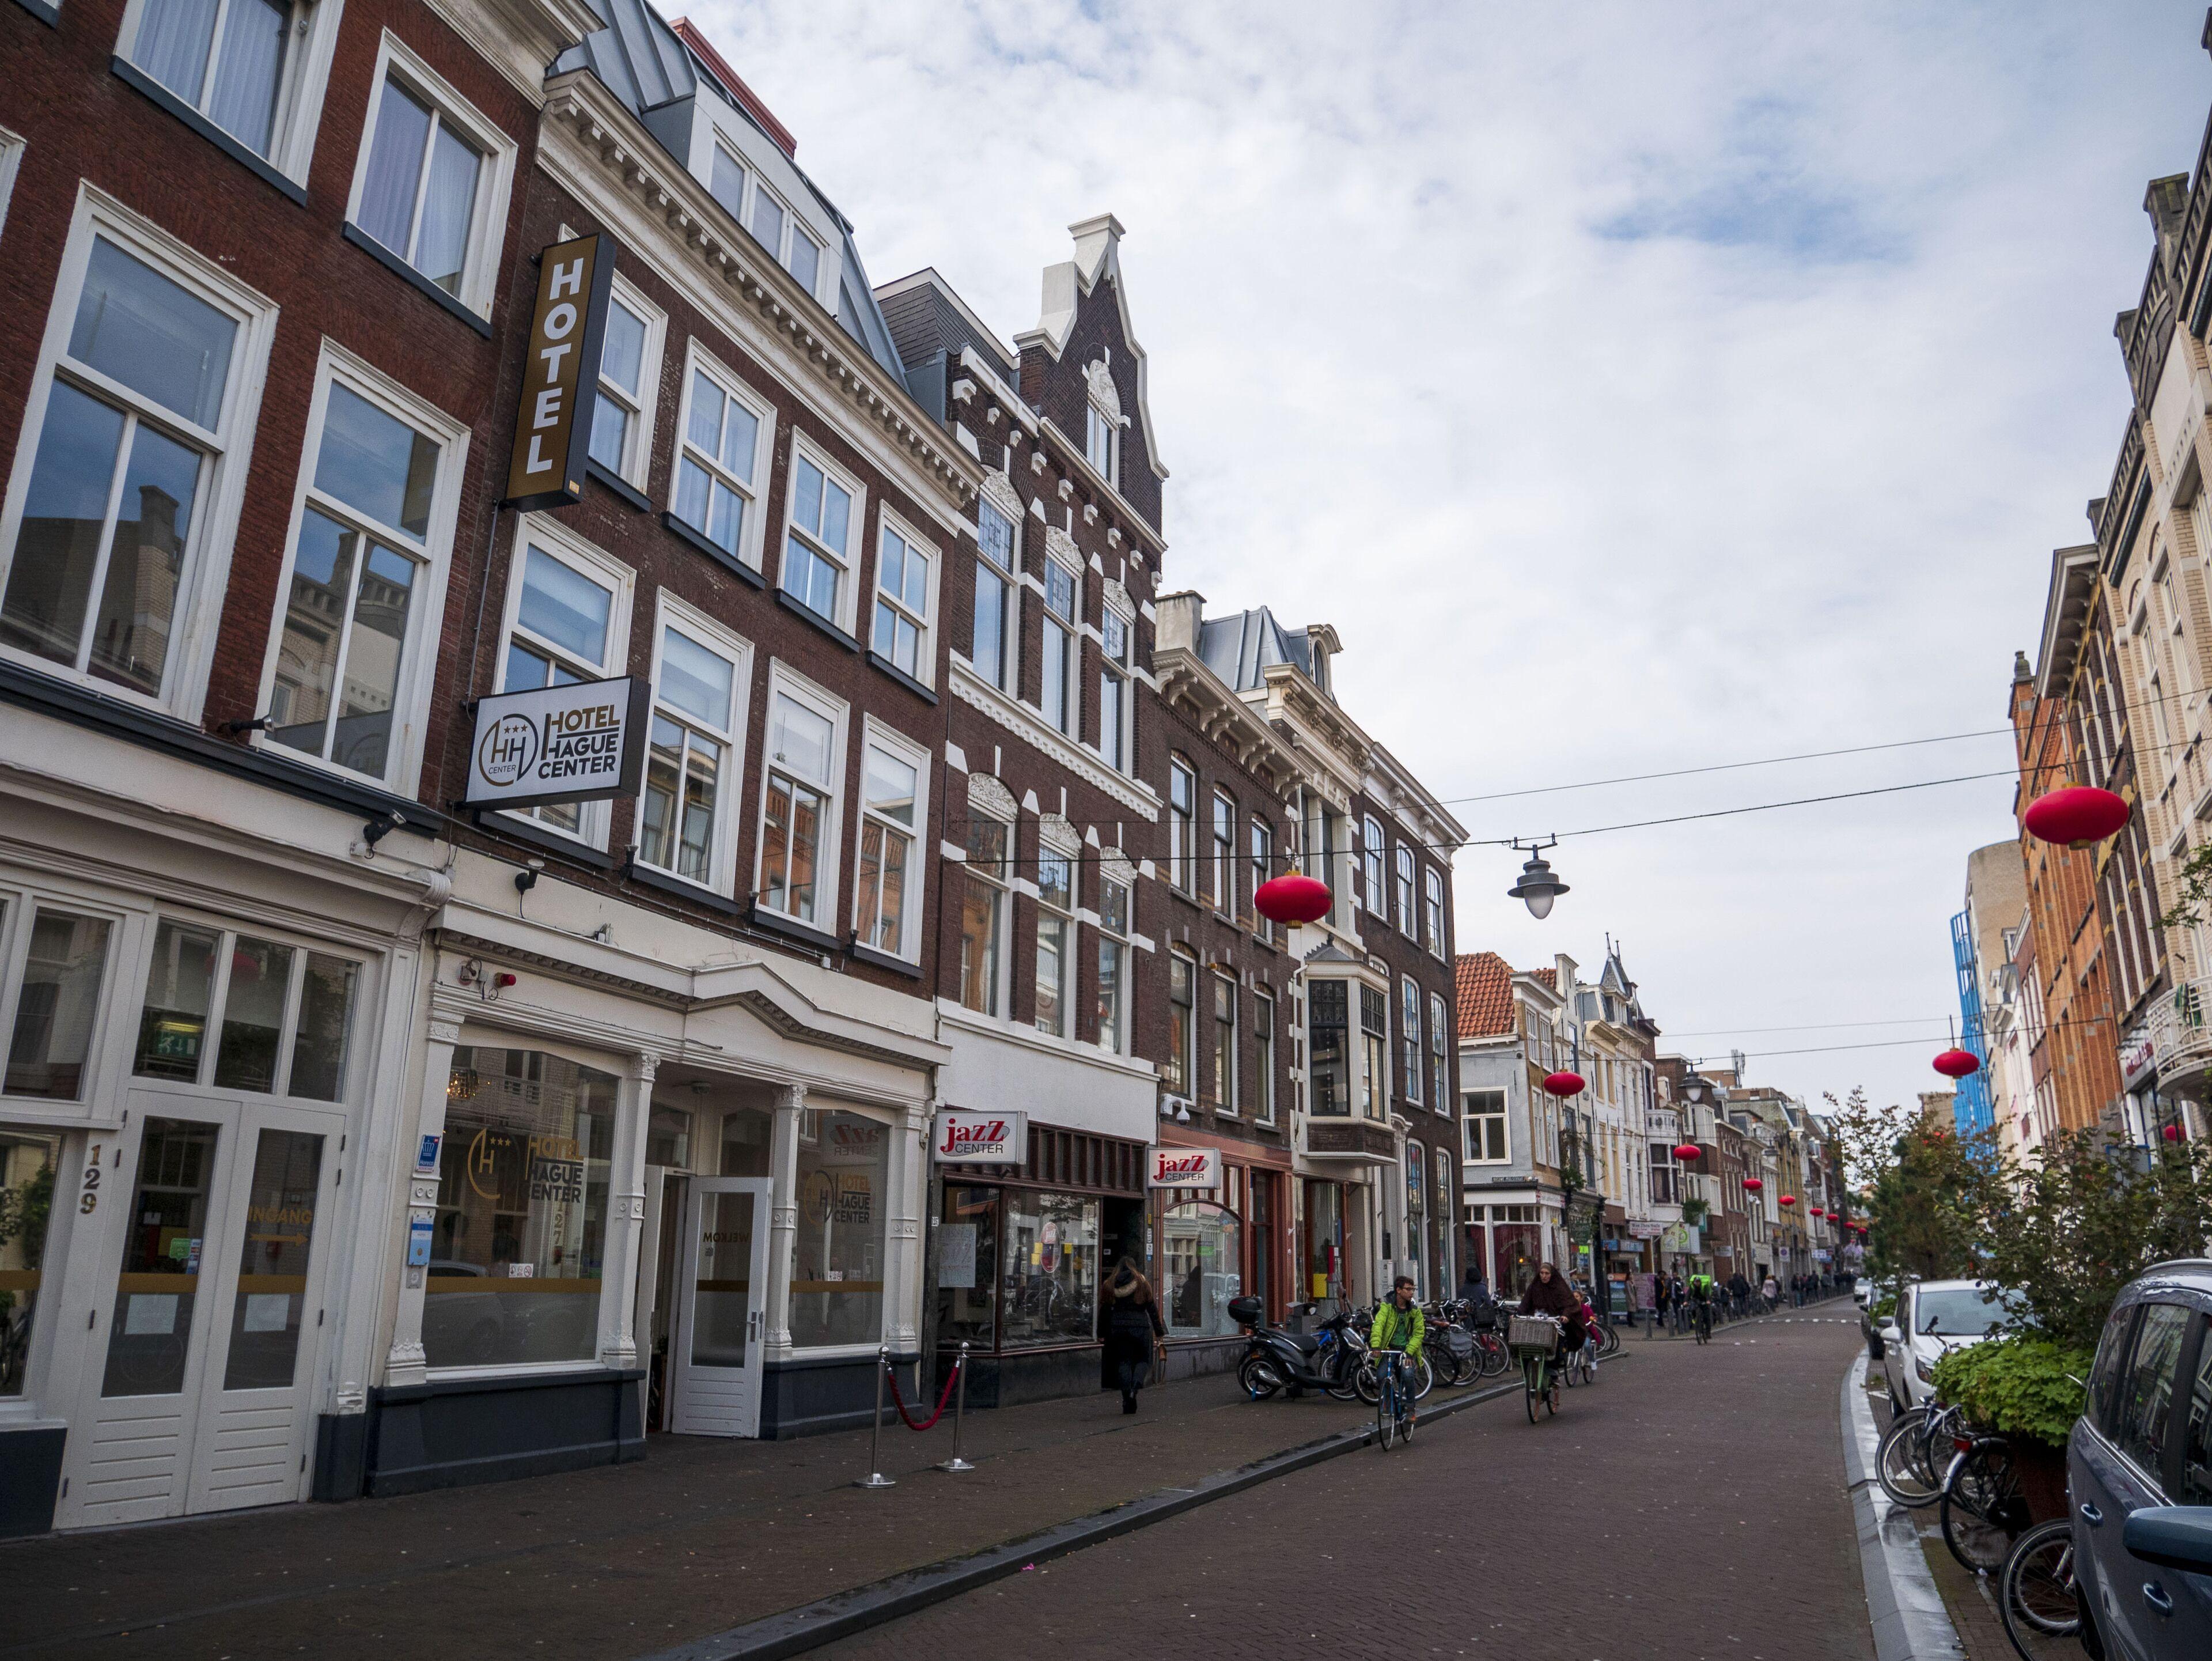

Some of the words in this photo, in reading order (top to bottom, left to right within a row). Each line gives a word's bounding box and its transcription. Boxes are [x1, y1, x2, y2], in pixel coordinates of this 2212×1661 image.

[527, 258, 584, 474] HOTEL
[545, 704, 621, 733] HOTEL
[540, 733, 620, 760] HAGUE
[488, 764, 516, 775] CENTER
[538, 755, 616, 779] CENTER
[527, 1134, 584, 1161] HOTEL
[955, 1143, 1003, 1153] CENTER
[79, 1144, 101, 1214] 129
[835, 1194, 870, 1210] HAGUE
[248, 1206, 313, 1224] INGANG
[835, 1210, 870, 1224] CENTER
